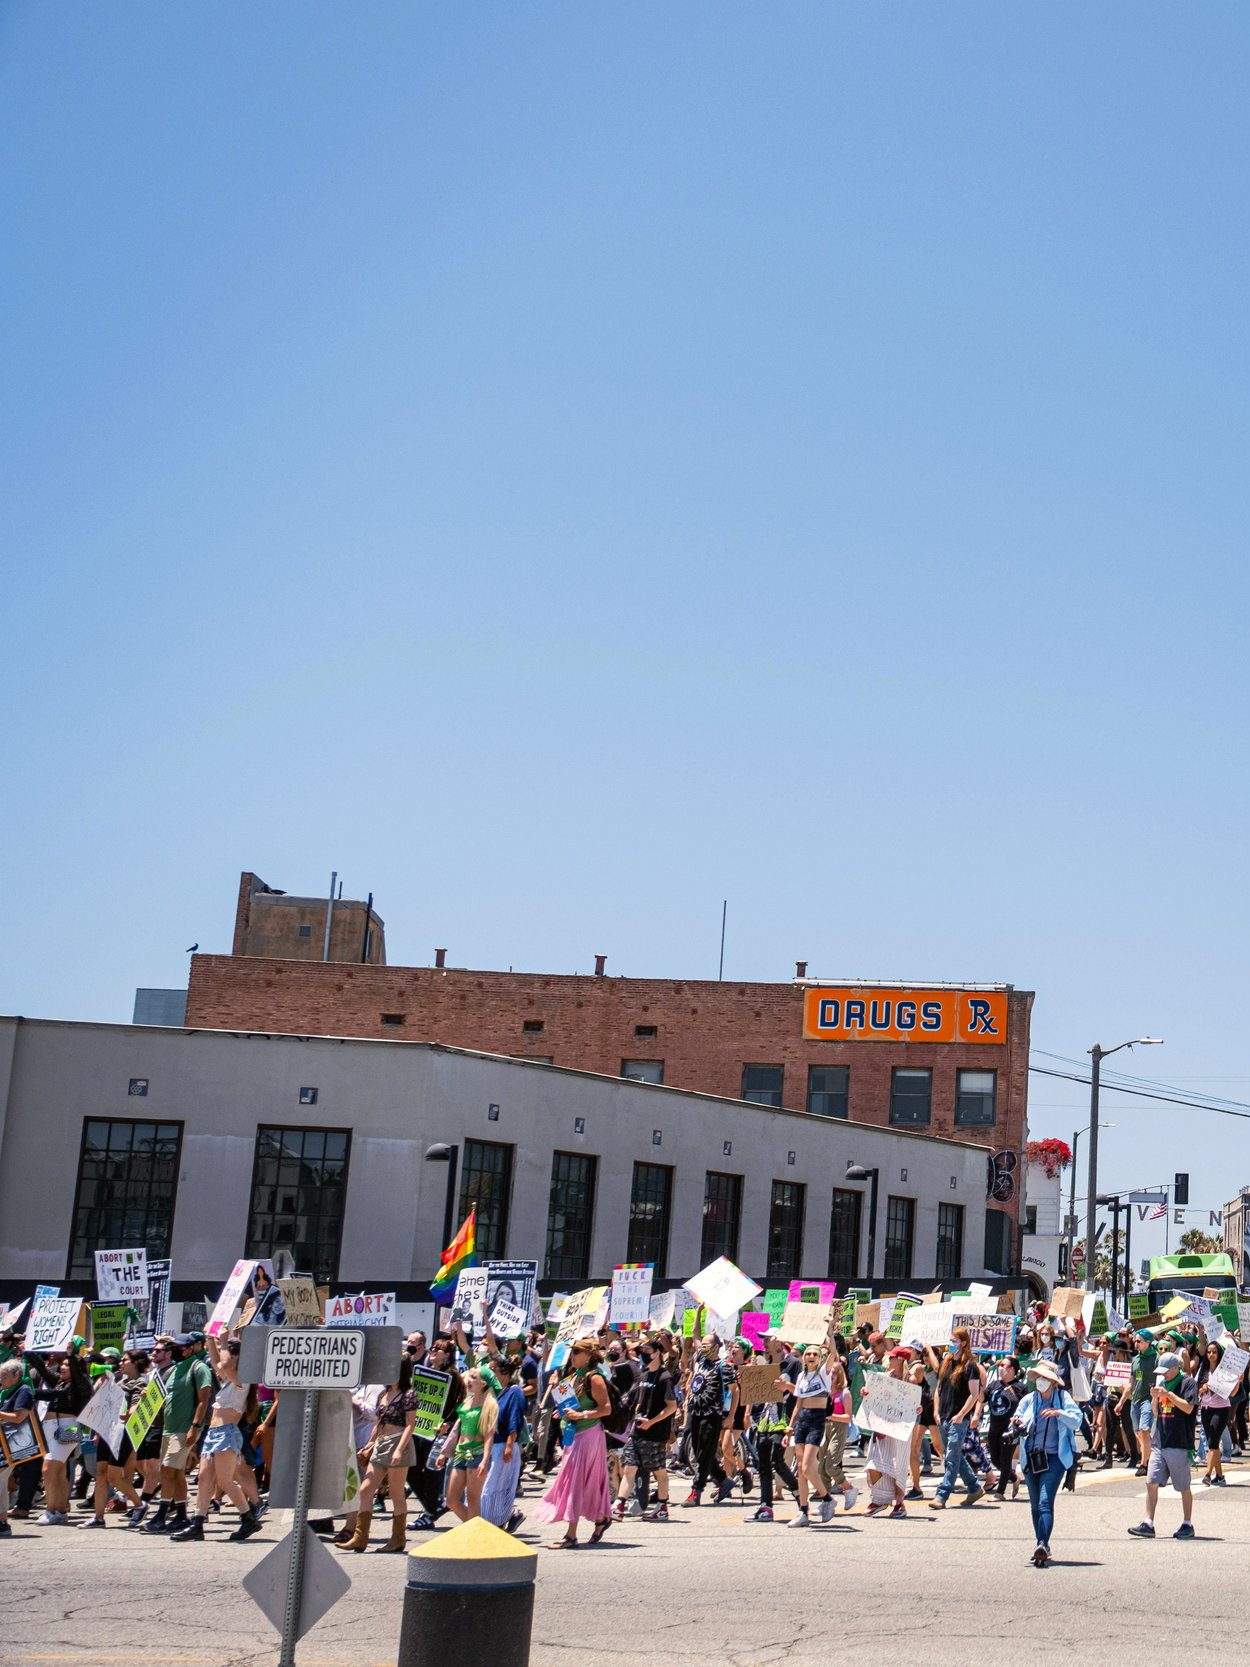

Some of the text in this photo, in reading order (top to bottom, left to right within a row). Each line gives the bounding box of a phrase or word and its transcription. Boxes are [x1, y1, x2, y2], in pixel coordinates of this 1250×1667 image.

[818, 999, 943, 1032] DRUGS
[99, 1253, 123, 1263] ABORT
[112, 1266, 141, 1282] THE
[618, 1271, 646, 1281] FUCK
[120, 1286, 144, 1296] COURT
[622, 1286, 639, 1294] THE
[38, 1300, 76, 1314] PROTECT
[332, 1294, 384, 1316] ABORT
[499, 1300, 515, 1313] THINK
[613, 1296, 648, 1306] SUPREME
[33, 1315, 67, 1327] WOMENS
[496, 1309, 520, 1324] OUTSIDE
[955, 1315, 1011, 1327] THIS IS SOME
[271, 1336, 358, 1356] PEDESTRIANS
[275, 1358, 351, 1378] PROHIBITED
[413, 1380, 429, 1395] RISE
[429, 1384, 439, 1397] UP
